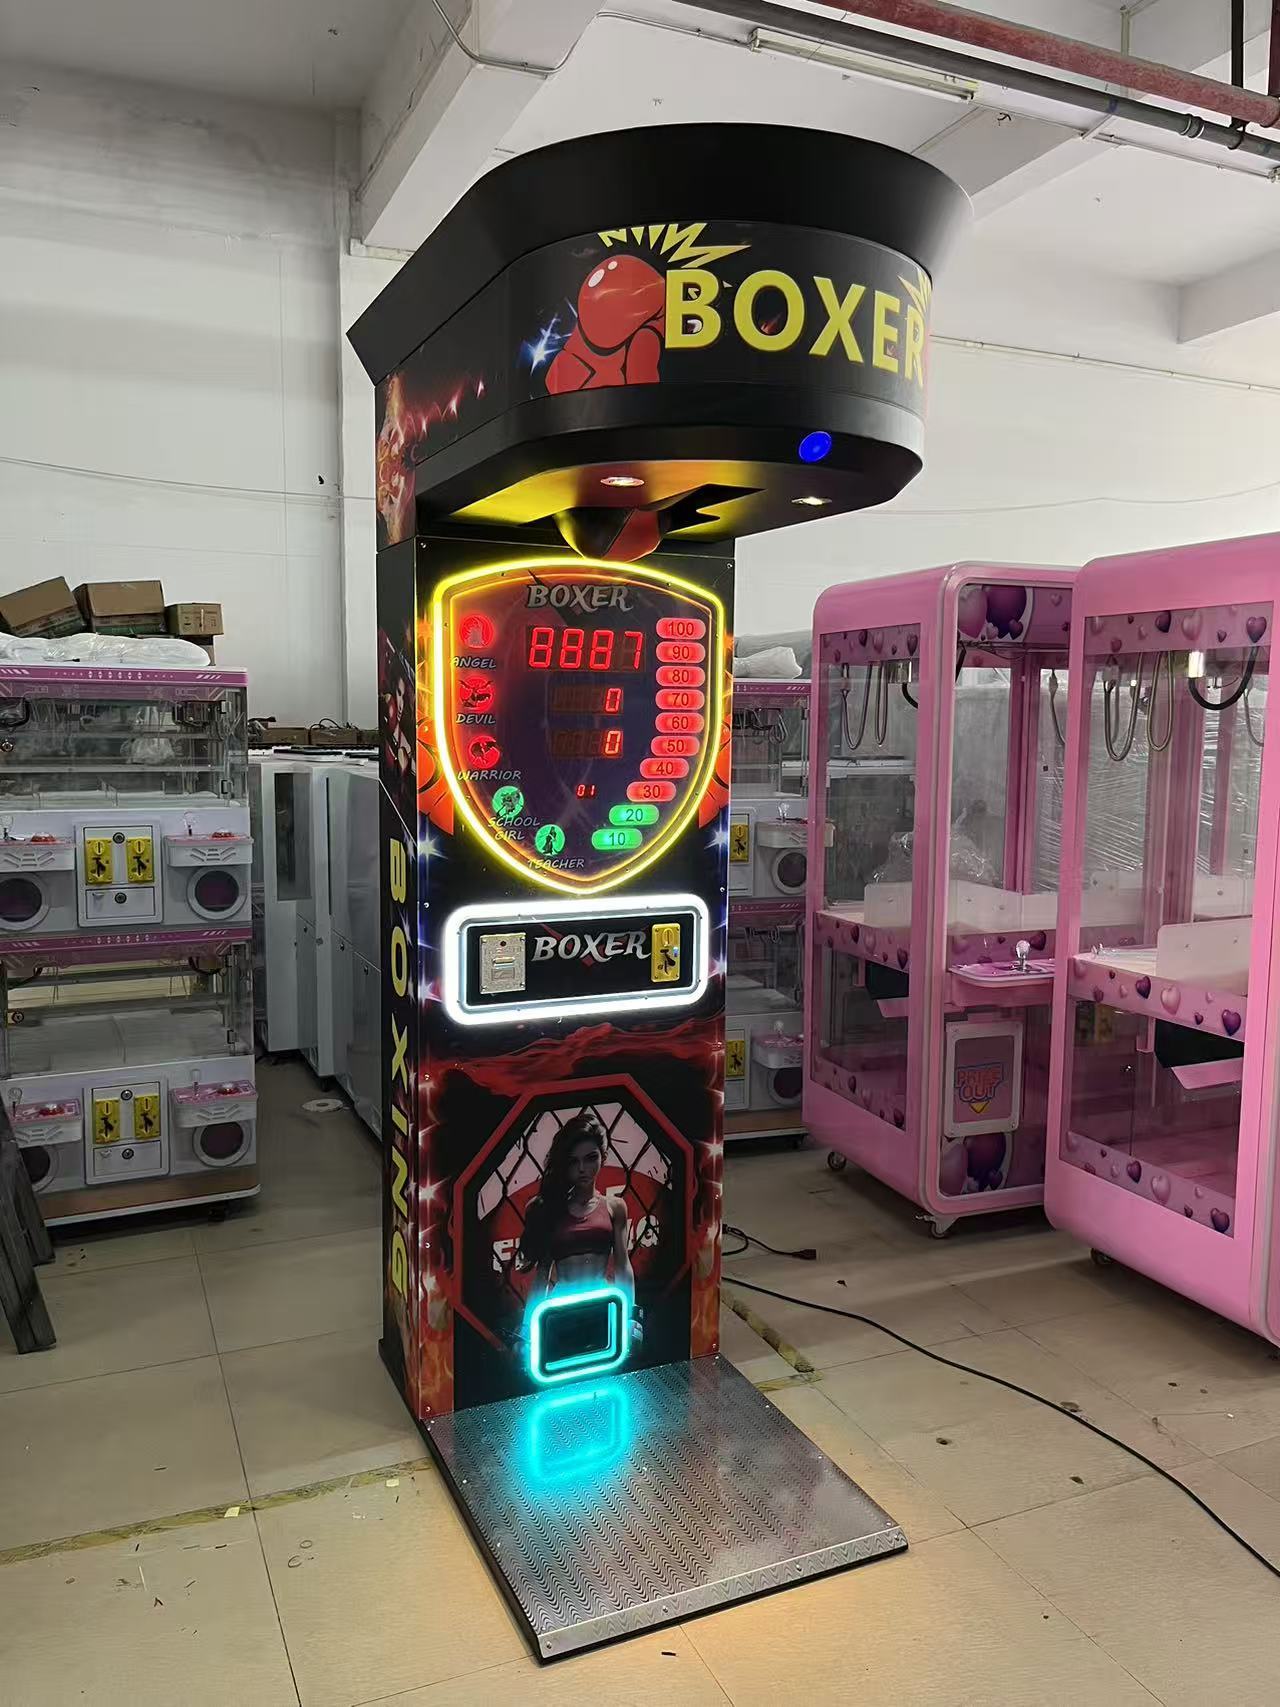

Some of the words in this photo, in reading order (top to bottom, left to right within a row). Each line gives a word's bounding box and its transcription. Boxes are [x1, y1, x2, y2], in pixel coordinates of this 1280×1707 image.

[665, 269, 925, 388] BOXER
[526, 584, 634, 612] BOXER
[667, 622, 695, 637] 100
[528, 627, 643, 670] 8887
[672, 645, 690, 659] 90
[452, 656, 497, 669] ANGEL
[672, 669, 690, 683] 80
[605, 687, 622, 713] 0
[672, 692, 690, 706] 70
[456, 713, 496, 724] DEVIL
[671, 716, 689, 730] 60
[605, 730, 621, 755] 0
[666, 739, 685, 753] 50
[457, 769, 522, 781] WARRIOR
[655, 761, 674, 775] 40
[643, 785, 661, 799] 30
[487, 816, 541, 828] SCHOOL
[625, 808, 643, 822] 20
[494, 830, 525, 840] GIRL
[608, 832, 626, 847] 10
[527, 859, 585, 869] TEACHER
[531, 930, 652, 963] BOXER
[390, 840, 409, 1298] BOXING
